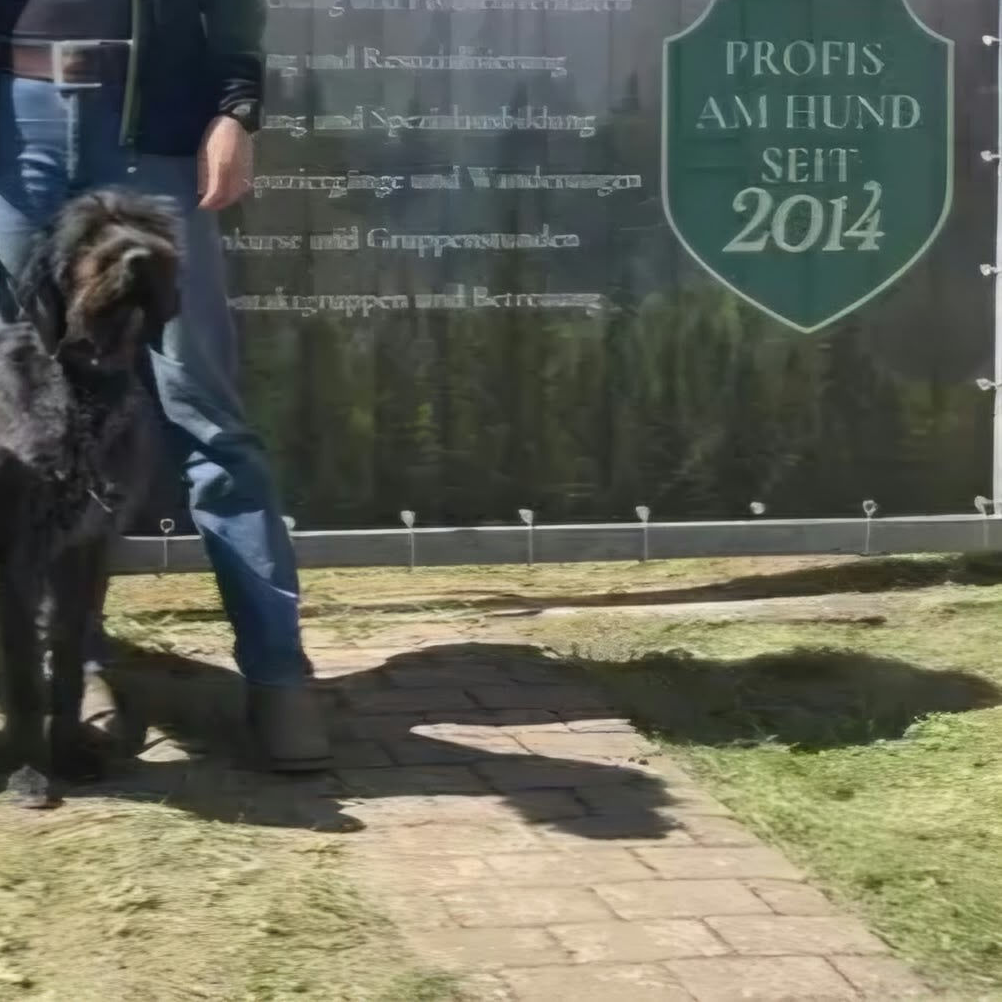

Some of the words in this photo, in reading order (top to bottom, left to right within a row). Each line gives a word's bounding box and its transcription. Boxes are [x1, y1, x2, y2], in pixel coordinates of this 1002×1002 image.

[726, 40, 885, 76] PROFIS
[696, 95, 767, 129] AM
[786, 94, 923, 129] HUND
[761, 147, 860, 183] SEIT
[722, 180, 885, 253] 2014
